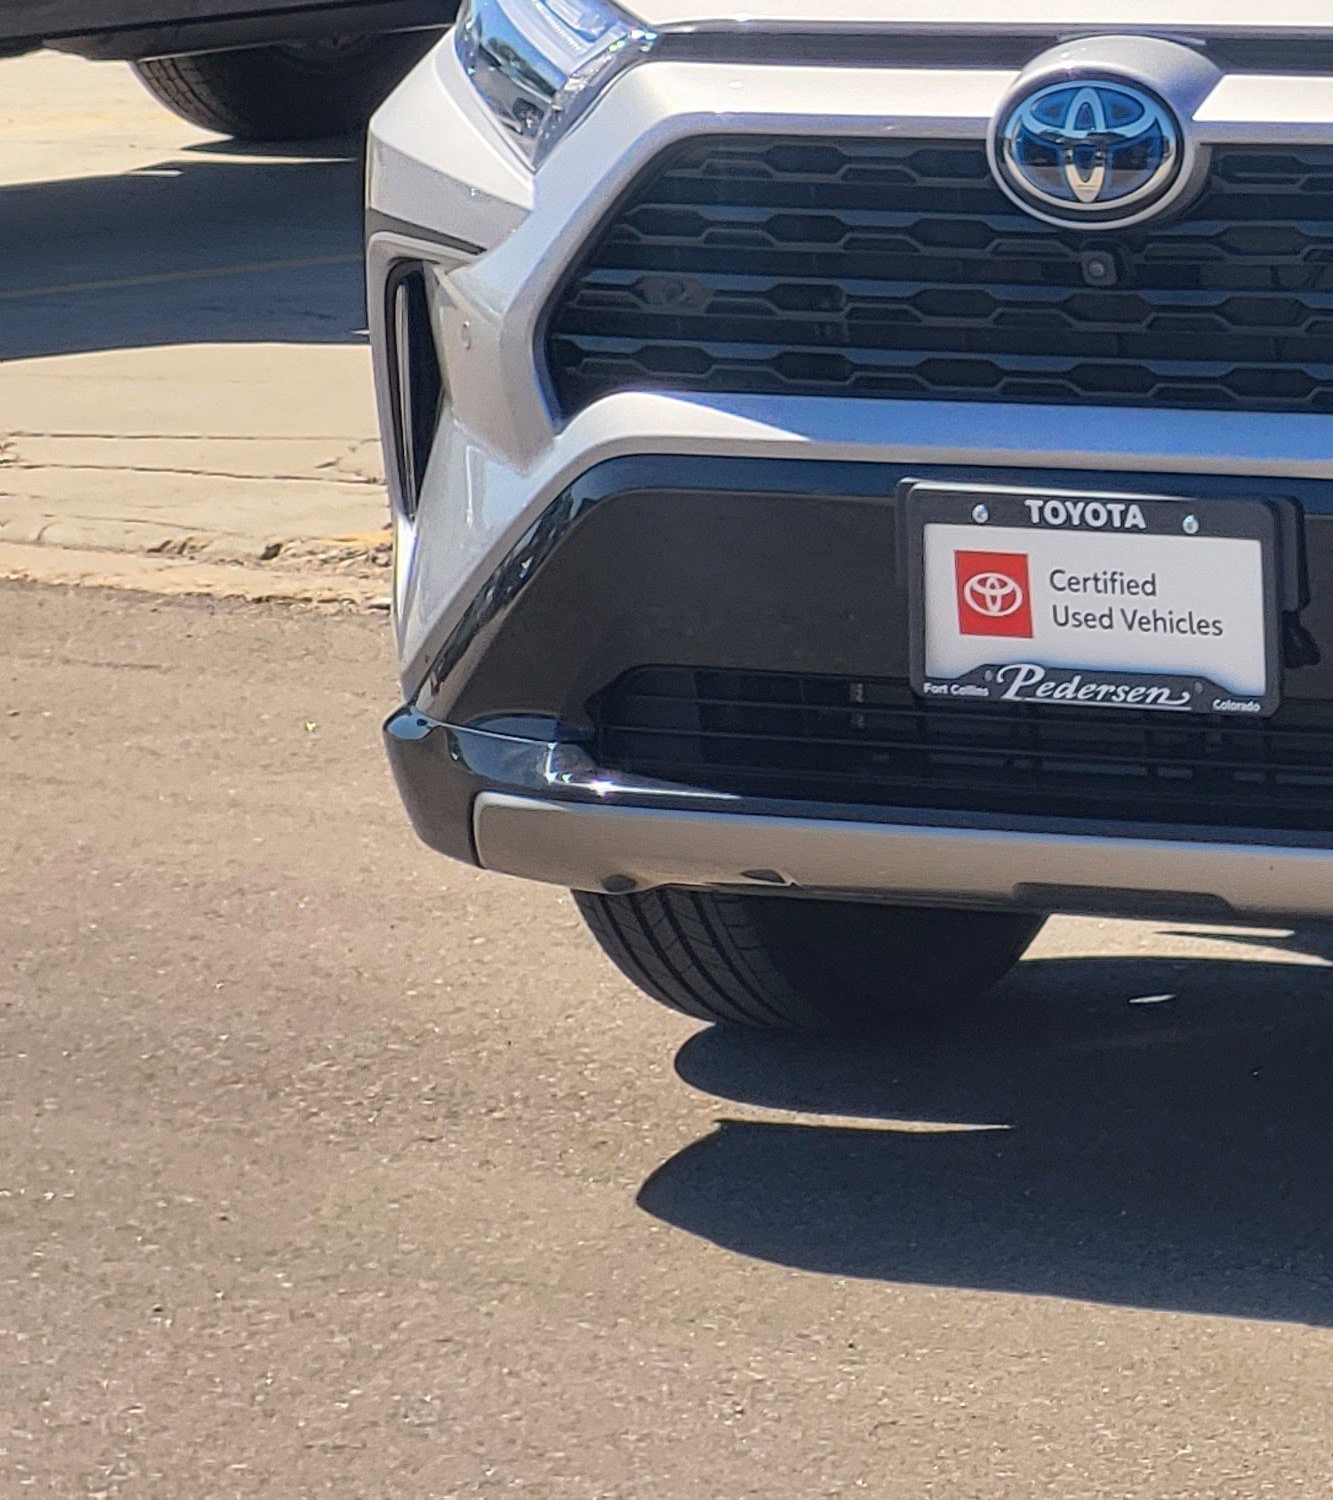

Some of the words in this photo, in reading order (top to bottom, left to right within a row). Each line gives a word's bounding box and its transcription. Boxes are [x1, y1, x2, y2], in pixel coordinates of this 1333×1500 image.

[1024, 498, 1148, 530] TOYOTA
[1049, 568, 1158, 597] Certified
[1051, 604, 1115, 631] Used
[1120, 606, 1225, 638] Vehicles
[923, 682, 949, 696] Fort
[950, 683, 990, 698] Collins
[995, 662, 1193, 707] Pedersen
[1211, 698, 1263, 714] Colorado
